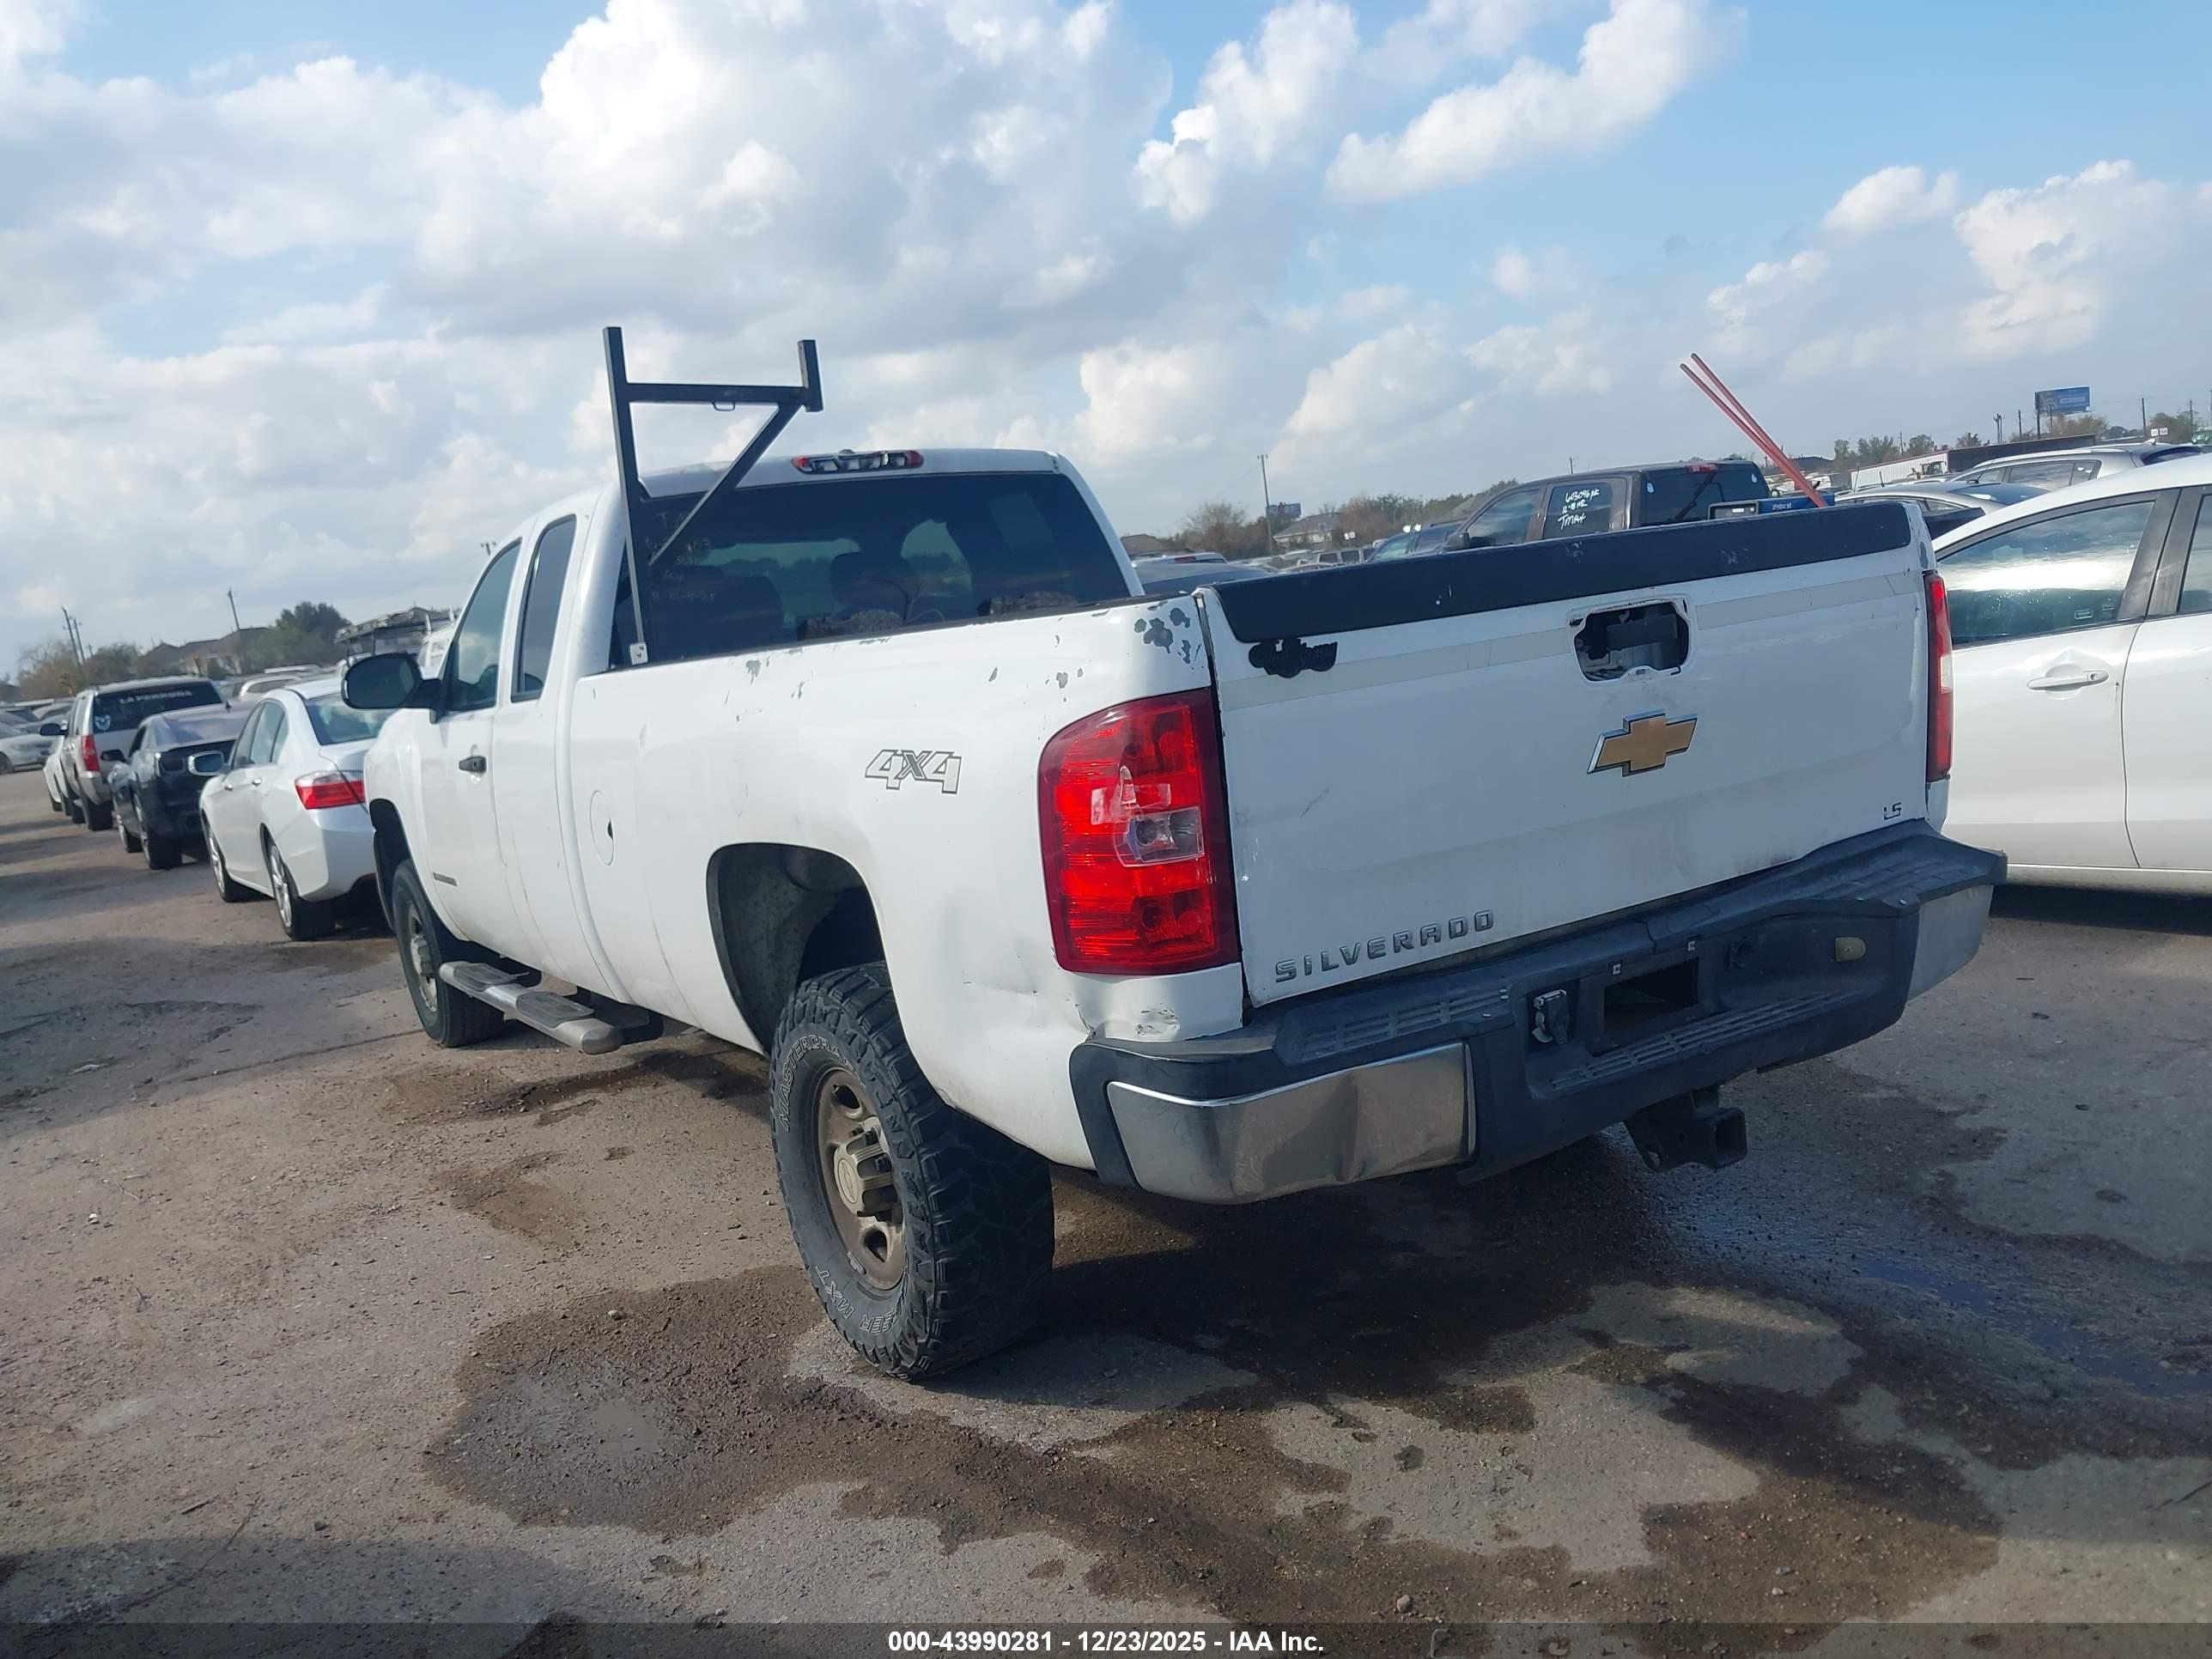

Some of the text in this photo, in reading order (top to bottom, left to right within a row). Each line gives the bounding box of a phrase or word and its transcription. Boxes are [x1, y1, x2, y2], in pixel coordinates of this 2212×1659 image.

[1883, 802, 1902, 821] LS
[1274, 909, 1495, 983] SILVERADO
[814, 1266, 856, 1320] MXT
